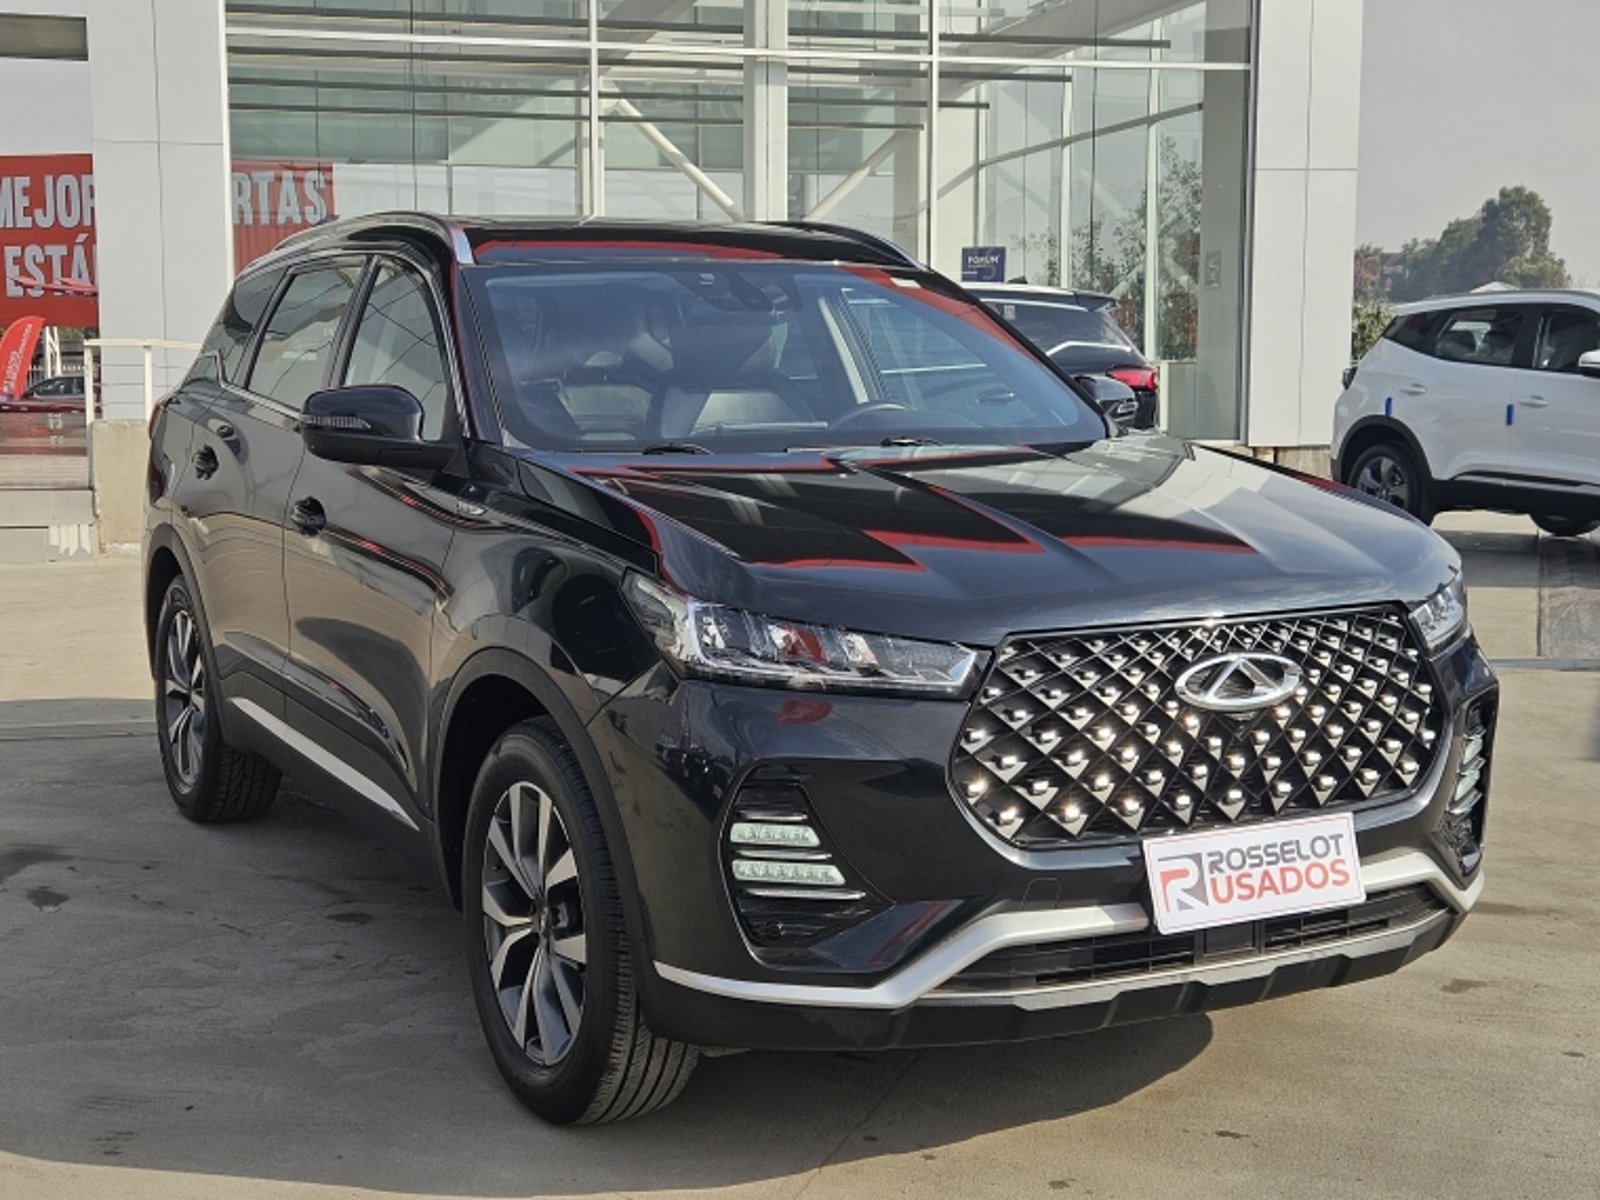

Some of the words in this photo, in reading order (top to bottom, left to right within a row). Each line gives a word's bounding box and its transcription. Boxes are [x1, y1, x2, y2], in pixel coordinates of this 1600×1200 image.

[4, 233, 97, 298] ESTÁ
[967, 255, 999, 264] FORUM
[1206, 833, 1344, 875] ROSSELOT
[1209, 858, 1350, 905] USADOS
